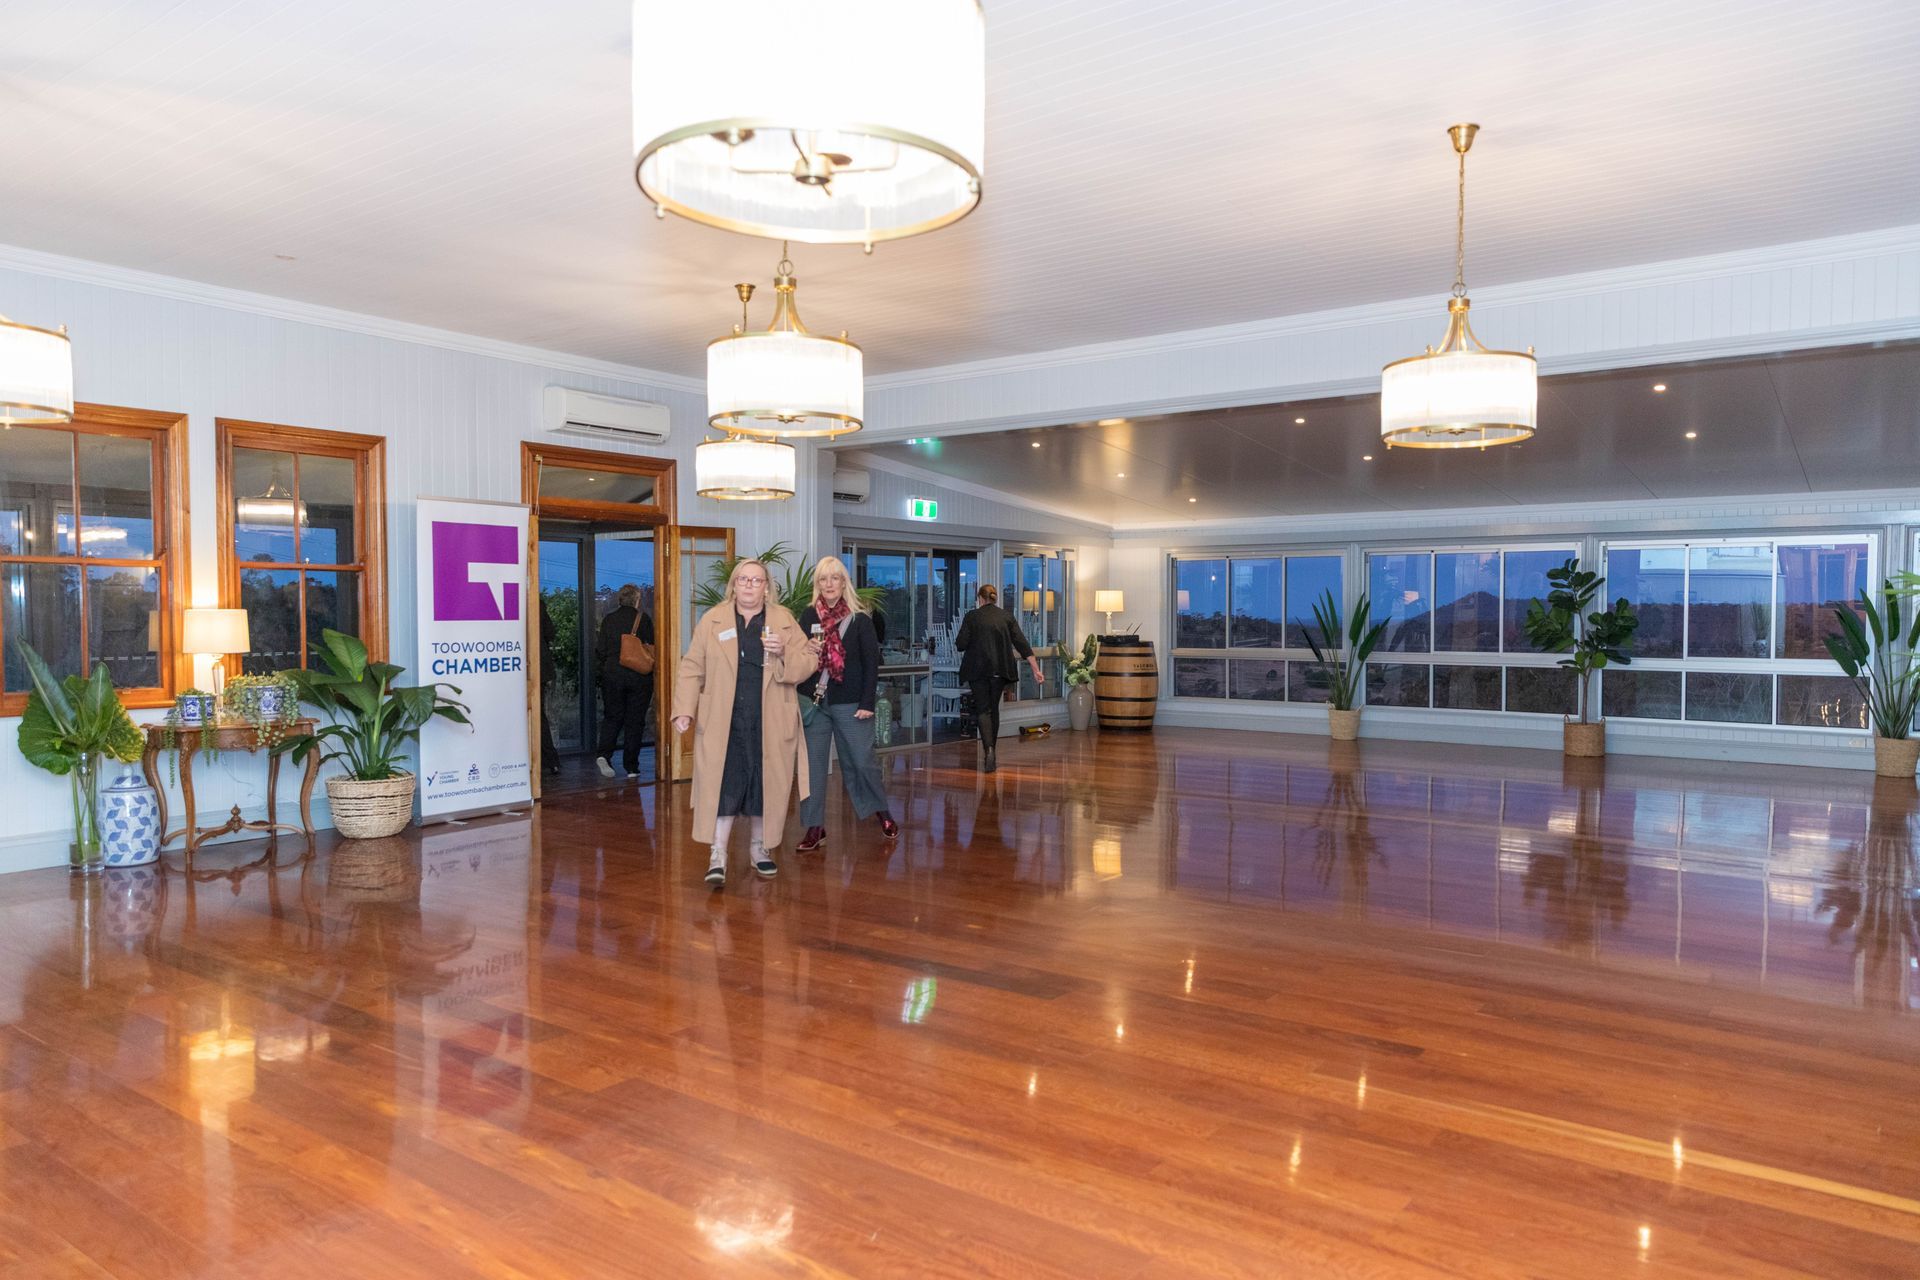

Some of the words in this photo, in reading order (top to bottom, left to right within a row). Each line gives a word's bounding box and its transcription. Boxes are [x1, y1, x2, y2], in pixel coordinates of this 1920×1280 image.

[432, 641, 521, 653] TOOWOOMBA
[432, 657, 521, 675] CHAMBER
[427, 781, 527, 800] www.toowoombachamber.com.au
